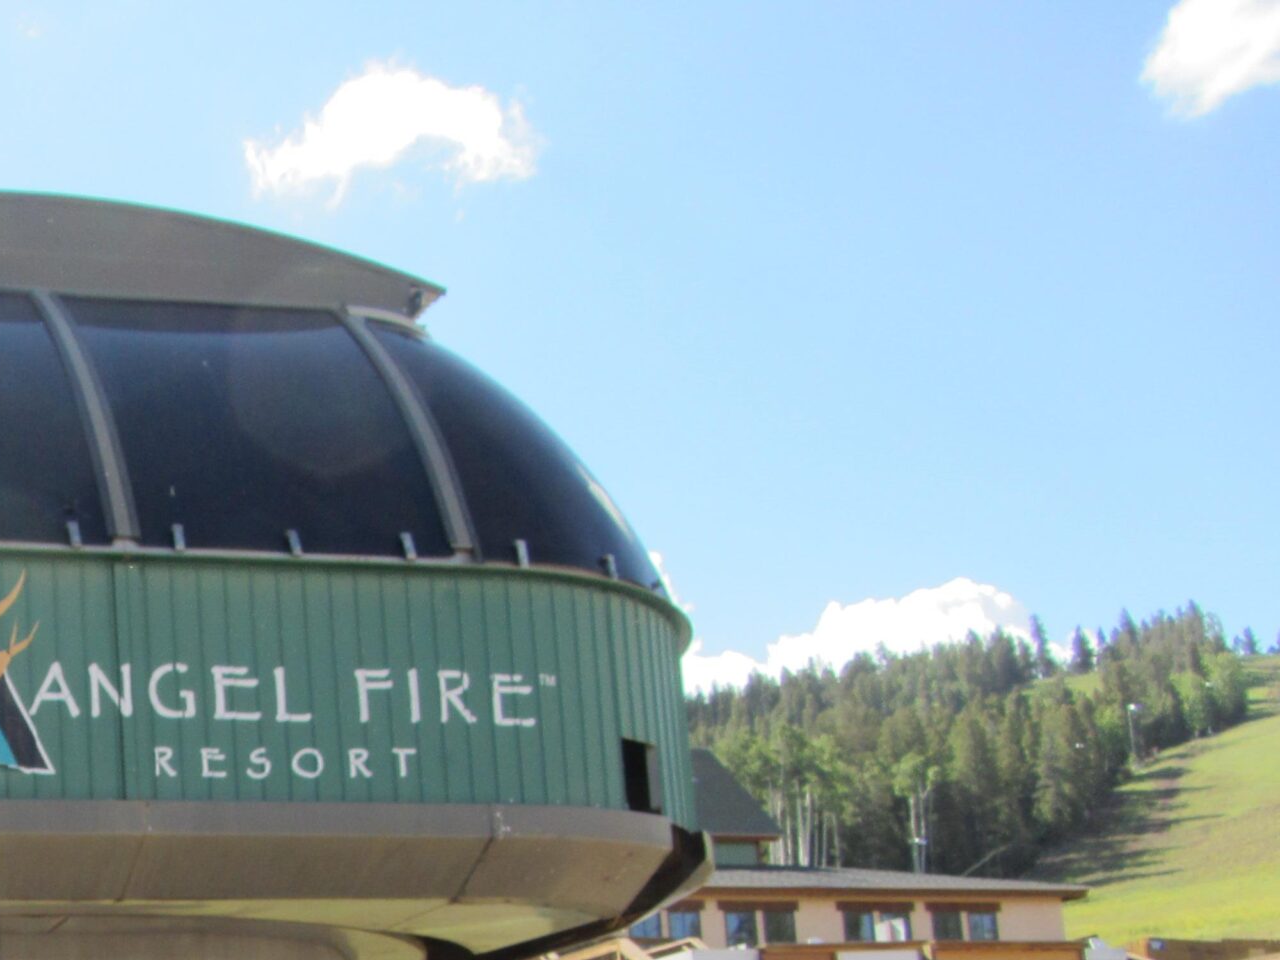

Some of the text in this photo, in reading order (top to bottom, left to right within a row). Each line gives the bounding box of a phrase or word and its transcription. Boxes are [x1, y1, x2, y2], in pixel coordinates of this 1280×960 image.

[30, 661, 312, 724] ANGEL
[355, 667, 538, 728] FIRE
[153, 746, 419, 780] RESORT
